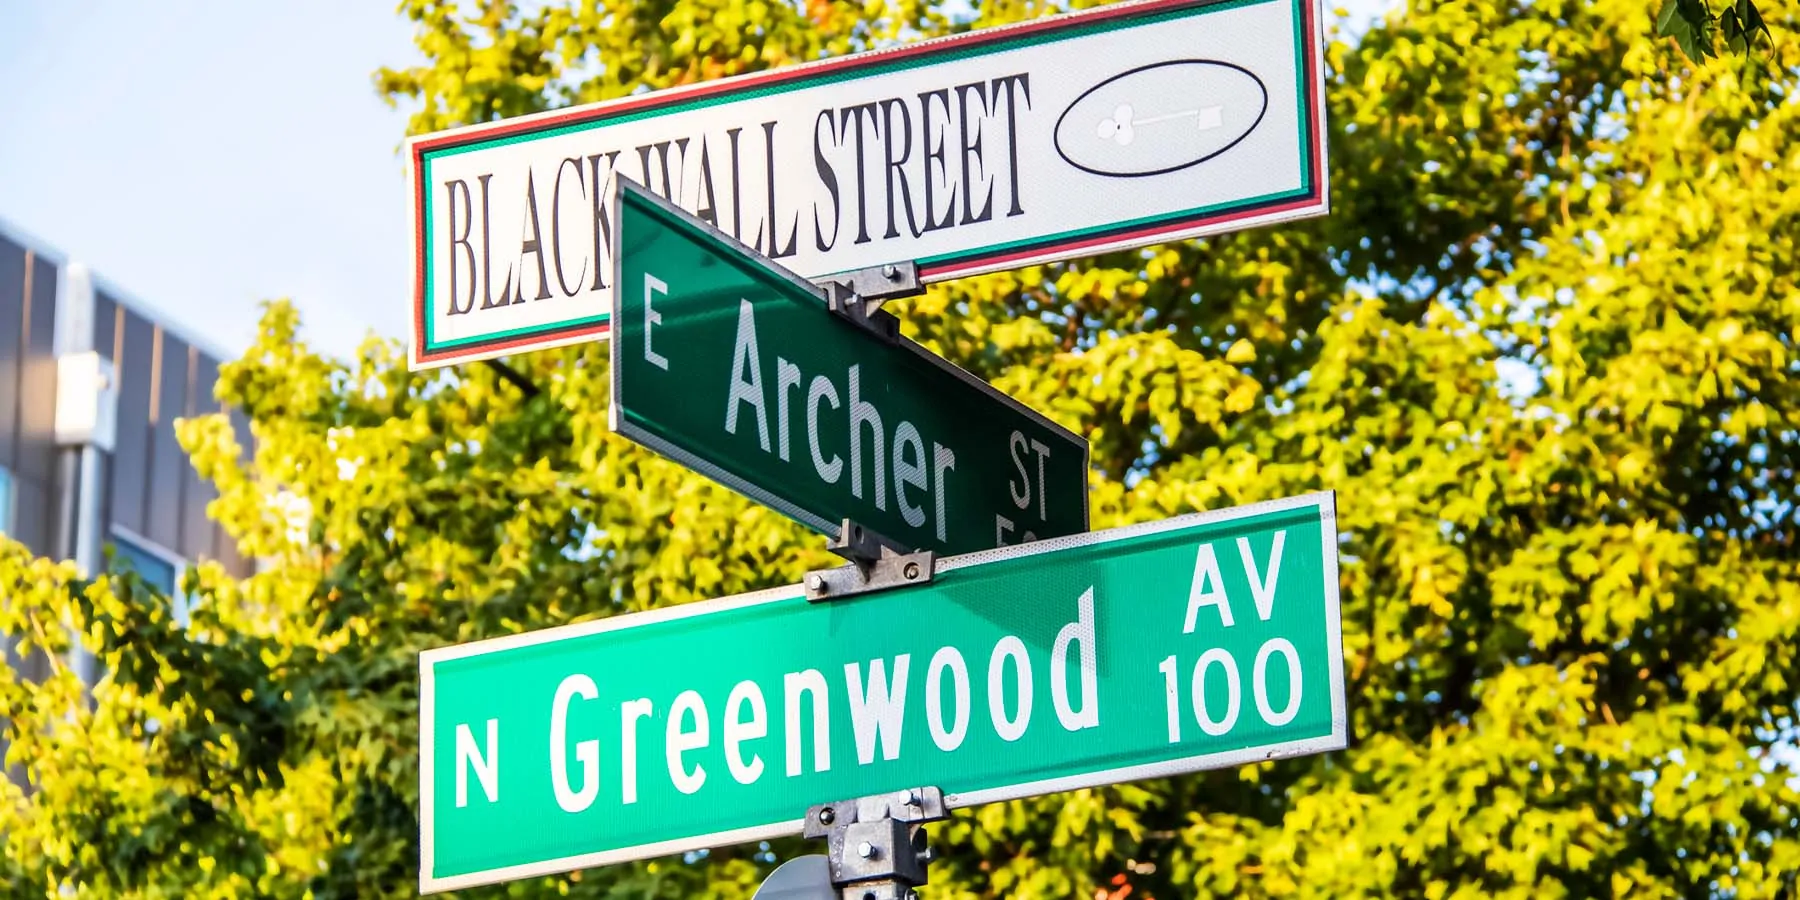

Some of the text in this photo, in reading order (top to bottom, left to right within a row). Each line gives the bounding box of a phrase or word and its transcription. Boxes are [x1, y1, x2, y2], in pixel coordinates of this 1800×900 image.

[444, 150, 621, 316] BLACK
[813, 72, 1032, 252] STREET
[643, 272, 956, 543] E Archer
[1009, 430, 1050, 521] ST
[1182, 530, 1287, 634] AV
[456, 584, 1100, 813] N Greenwood
[1158, 637, 1304, 744] 100
